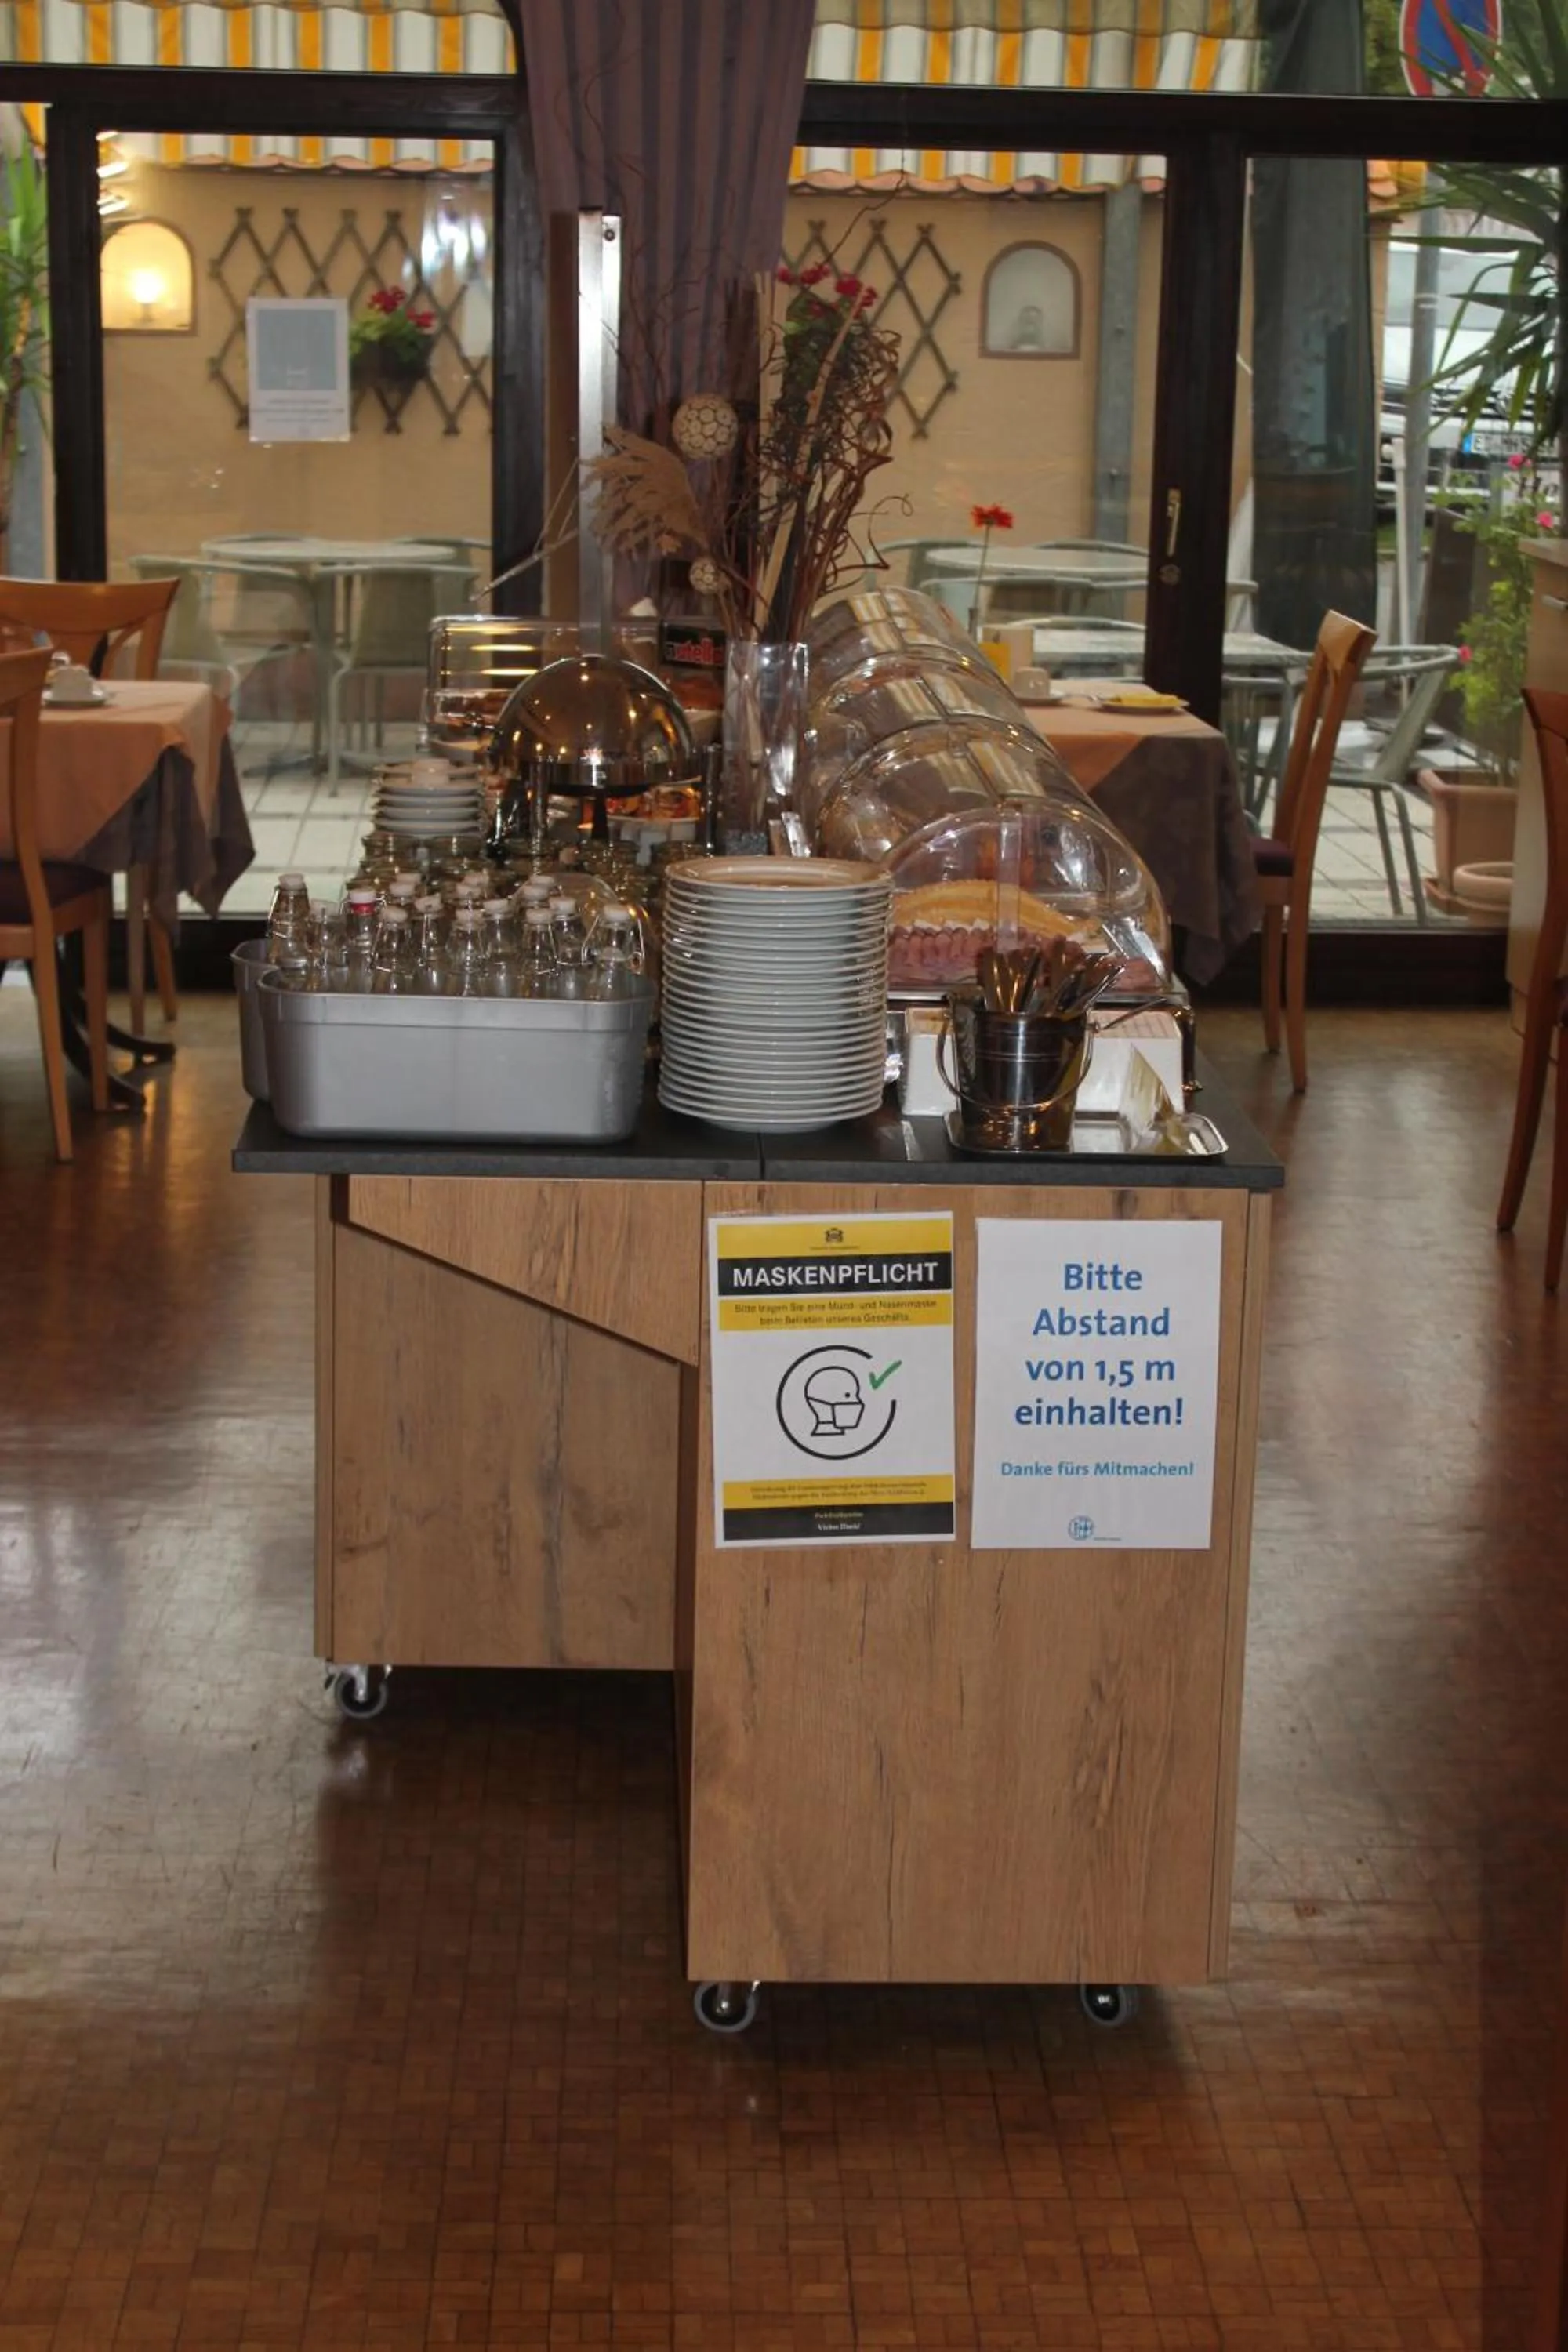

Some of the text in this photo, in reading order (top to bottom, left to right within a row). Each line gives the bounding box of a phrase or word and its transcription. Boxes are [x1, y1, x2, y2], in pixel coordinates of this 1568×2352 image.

[733, 1262, 938, 1287] MASKENPFLICHT
[1064, 1263, 1142, 1290] Bitte
[1033, 1308, 1170, 1336] Abstand
[1025, 1359, 1175, 1386] von 1,5 m
[1015, 1398, 1183, 1425] einhalten!
[1001, 1461, 1194, 1475] Danke fürs Mitmachen!
